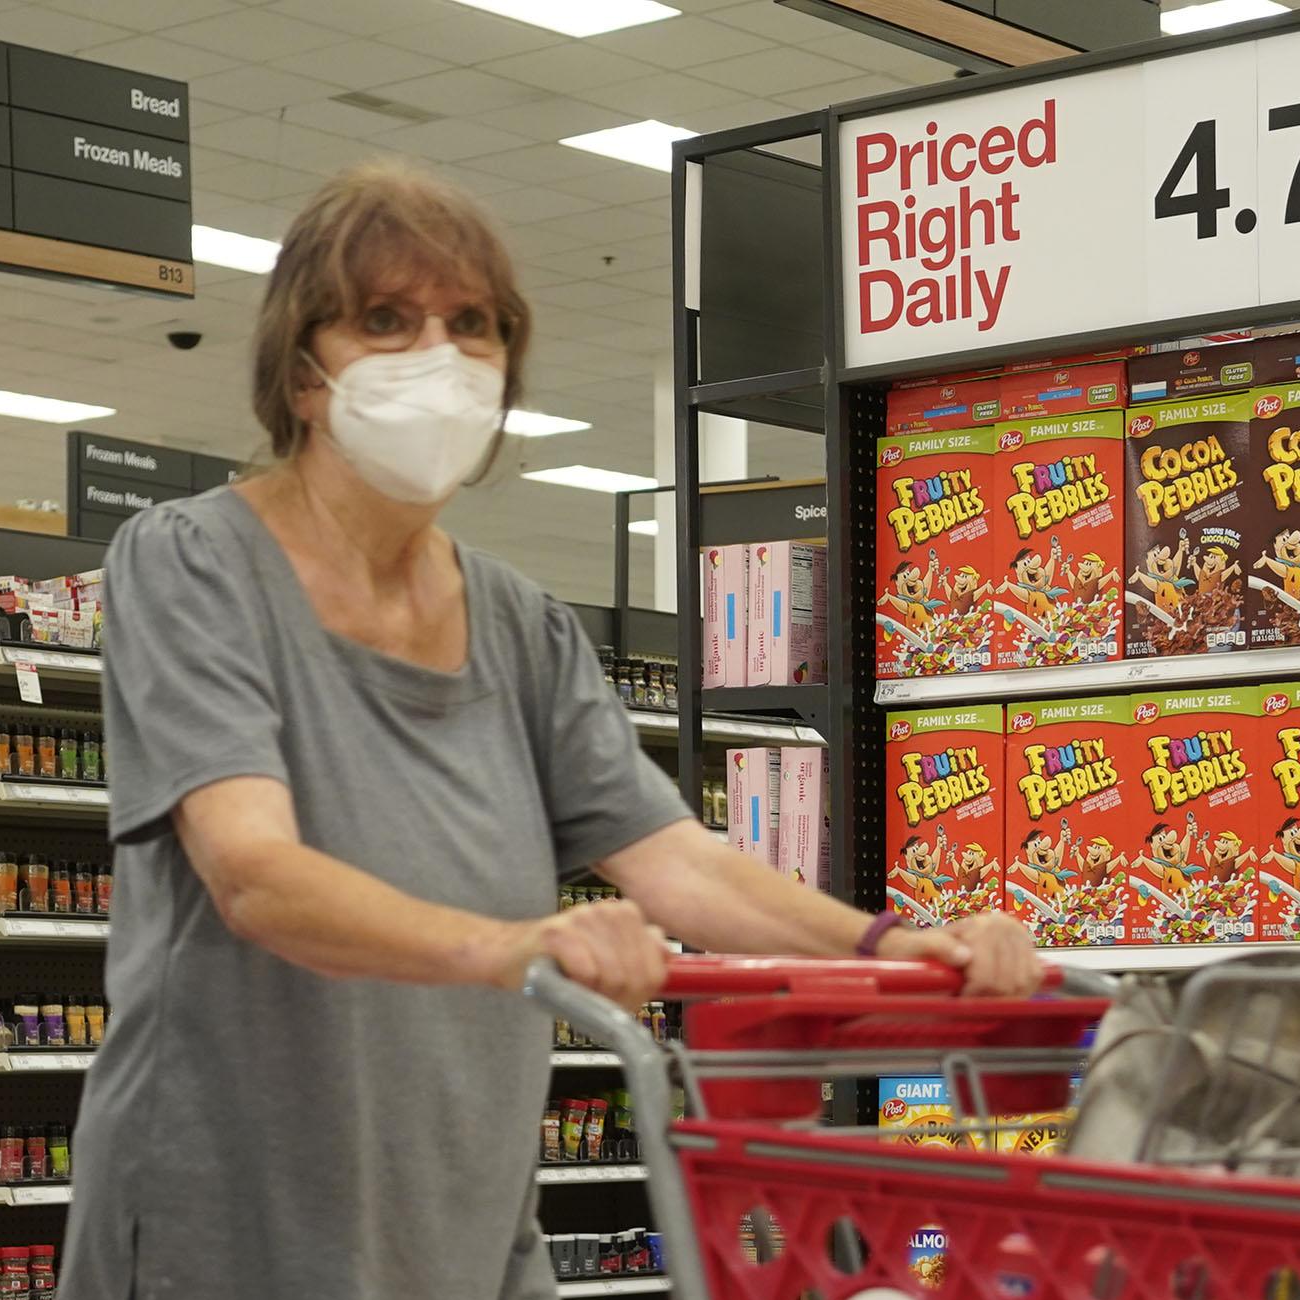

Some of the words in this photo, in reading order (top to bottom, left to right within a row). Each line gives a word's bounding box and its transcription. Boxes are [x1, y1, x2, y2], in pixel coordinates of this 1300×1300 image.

[130, 89, 180, 119] Bread
[855, 98, 1057, 198] Priced
[74, 137, 130, 169] Frozen
[133, 147, 182, 179] Meals
[857, 180, 1021, 270] Right
[158, 264, 184, 285] B13
[858, 258, 1012, 334] Daily
[1225, 366, 1249, 376] GLUTEN
[1227, 373, 1245, 381] FREE
[1090, 386, 1114, 395] GLUTEN
[1159, 408, 1199, 422] FAMILY
[1202, 403, 1227, 417] SIZE
[1256, 398, 1279, 416] Post
[1030, 424, 1069, 437] FAMILY
[1072, 420, 1096, 433] SIZE
[1130, 418, 1152, 435] Post
[909, 440, 945, 452] FAMILY
[948, 436, 971, 448] SIZE
[1000, 433, 1021, 449] Post
[86, 444, 124, 465] Frozen
[124, 450, 157, 471] Meals
[882, 447, 901, 463] Post
[1140, 434, 1226, 482] COCOA
[87, 485, 124, 505] Frozen
[1136, 460, 1238, 528] PEBBLES
[1006, 473, 1111, 540] PEBBLES
[888, 487, 985, 552] PEBBLES
[1164, 698, 1203, 710] FAMILY
[1206, 694, 1233, 706] SIZE
[1265, 695, 1287, 712] Post
[1041, 706, 1078, 719] FAMILY
[1080, 704, 1105, 717] SIZE
[1136, 705, 1157, 720] Post
[917, 715, 953, 728] FAMILY
[955, 713, 978, 726] SIZE
[1012, 713, 1034, 729] Post
[890, 722, 910, 739] Post
[1018, 757, 1118, 820] PEBBLES
[1141, 750, 1247, 815] PEBBLES
[897, 765, 991, 826] PEBBLES
[896, 1083, 942, 1099] GIANT
[883, 1101, 904, 1116] Post
